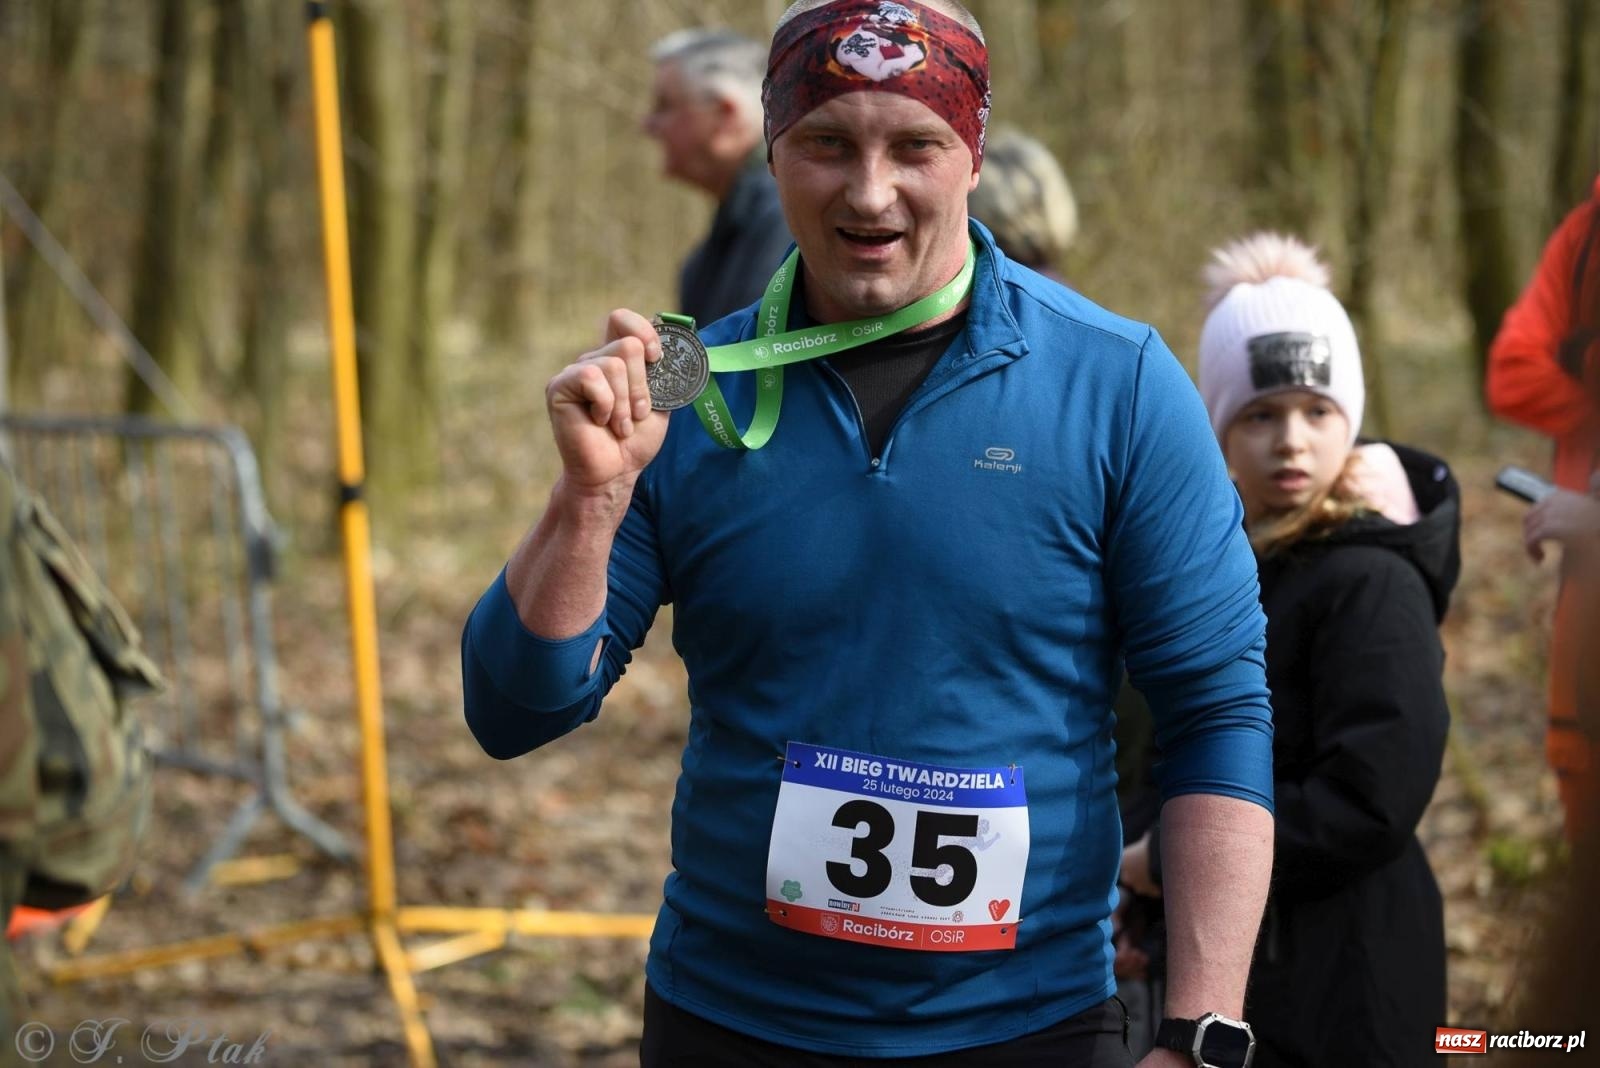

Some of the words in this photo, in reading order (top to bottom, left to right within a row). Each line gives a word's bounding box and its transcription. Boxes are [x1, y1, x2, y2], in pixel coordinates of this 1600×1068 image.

[773, 333, 837, 355] Racibórz
[852, 321, 884, 337] OSiR
[974, 459, 1022, 474] Kalenji
[814, 752, 837, 770] XII
[841, 757, 883, 776] BIEG
[886, 764, 1005, 789] TWARDZIELA
[862, 778, 877, 791] 25
[880, 782, 920, 799] lutego
[923, 787, 954, 802] 2024
[826, 799, 979, 907] 35
[843, 919, 914, 941] Racibórz
[930, 930, 965, 943] OSiR
